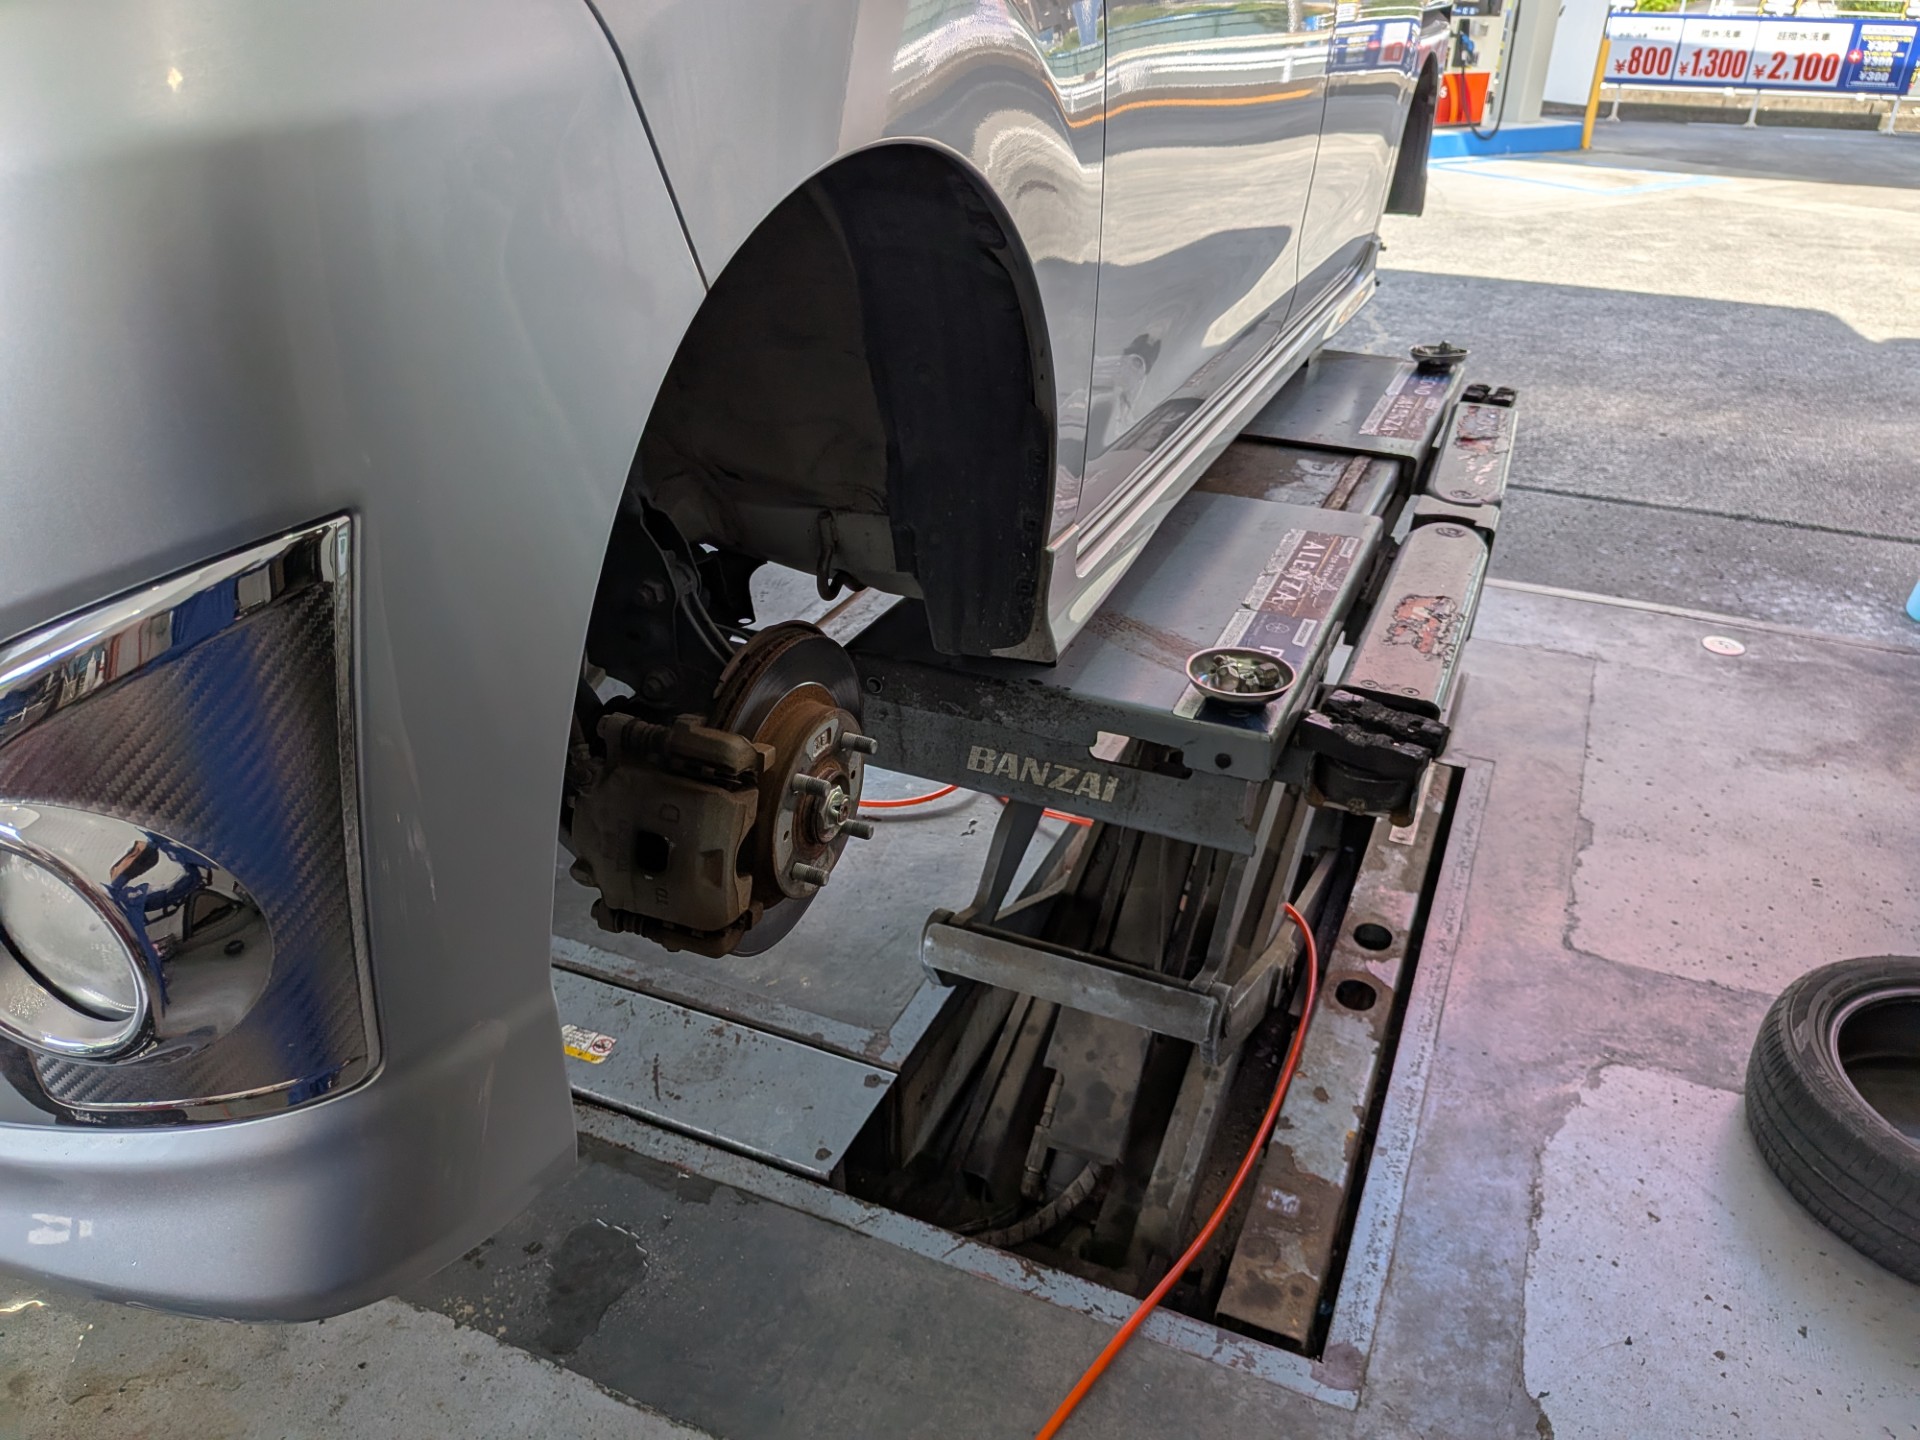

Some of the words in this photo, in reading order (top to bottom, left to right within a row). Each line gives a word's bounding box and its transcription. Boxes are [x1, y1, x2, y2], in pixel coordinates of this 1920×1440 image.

[1614, 45, 1673, 76] ¥800
[1678, 48, 1748, 79] ¥1,300
[1753, 51, 1841, 82] ¥2,100
[1271, 540, 1326, 604] ALENZA
[967, 745, 1120, 803] BANZAI
